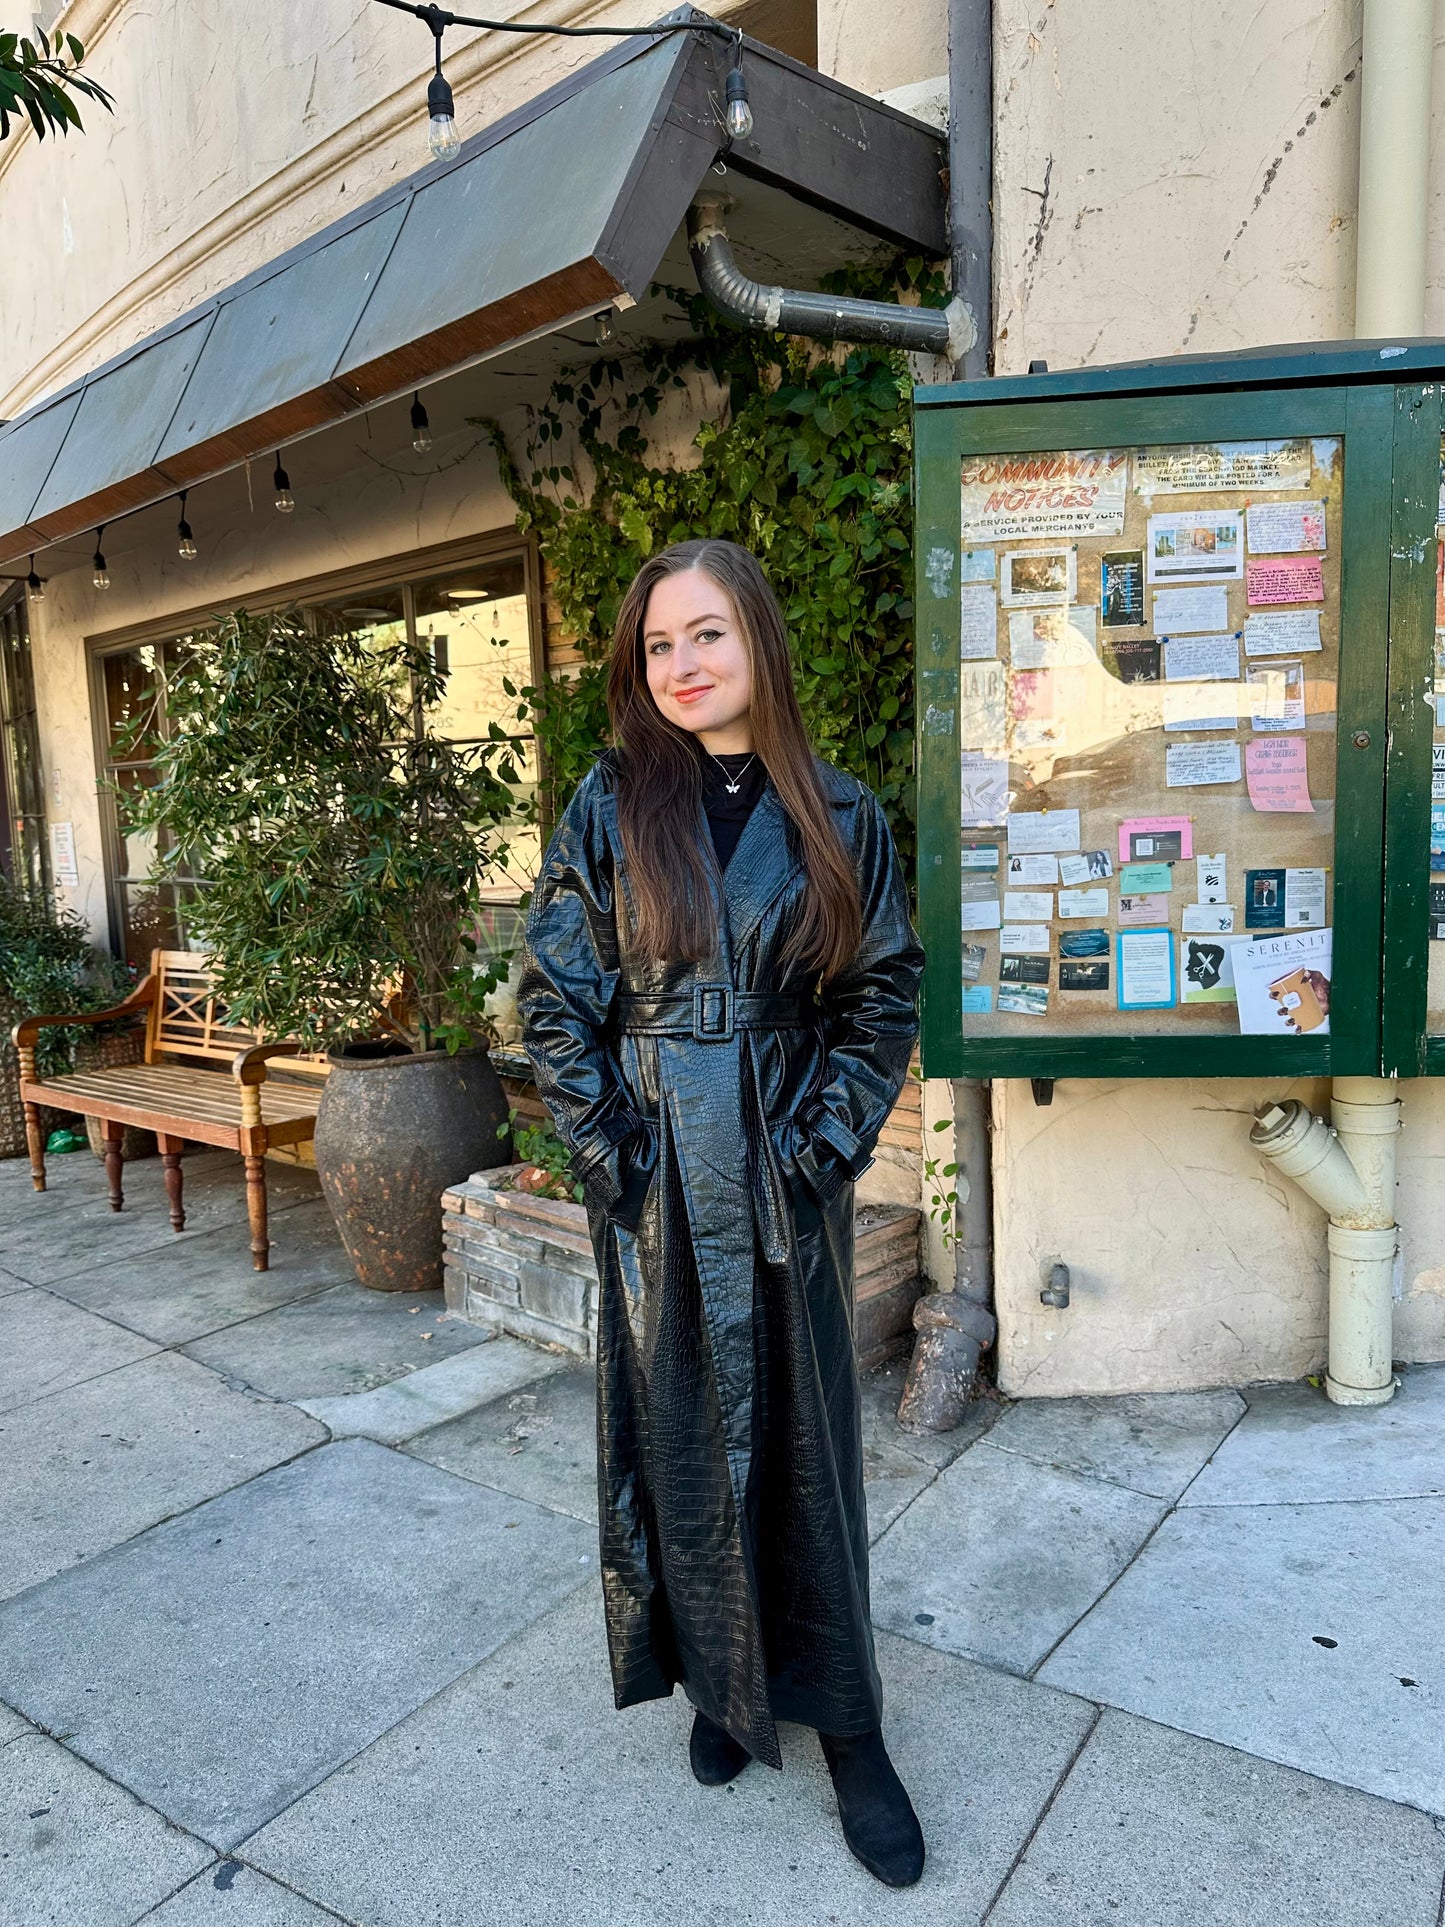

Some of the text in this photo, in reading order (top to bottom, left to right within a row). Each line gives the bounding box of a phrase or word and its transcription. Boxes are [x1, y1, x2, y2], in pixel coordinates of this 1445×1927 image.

[1137, 453, 1167, 462] ANYONE
[960, 454, 1126, 486] COMMUNITY
[1227, 471, 1256, 479] POSTED
[1172, 480, 1206, 489] MINIMUM
[983, 484, 1100, 514] NOTICES
[973, 518, 1018, 528] SERVICE
[1021, 514, 1074, 524] PROVIDED
[1076, 512, 1092, 520] BY
[1095, 511, 1124, 520] YOUR
[994, 522, 1096, 536] LOCAL MERCHANTS
[1247, 934, 1327, 957] SERENIT
